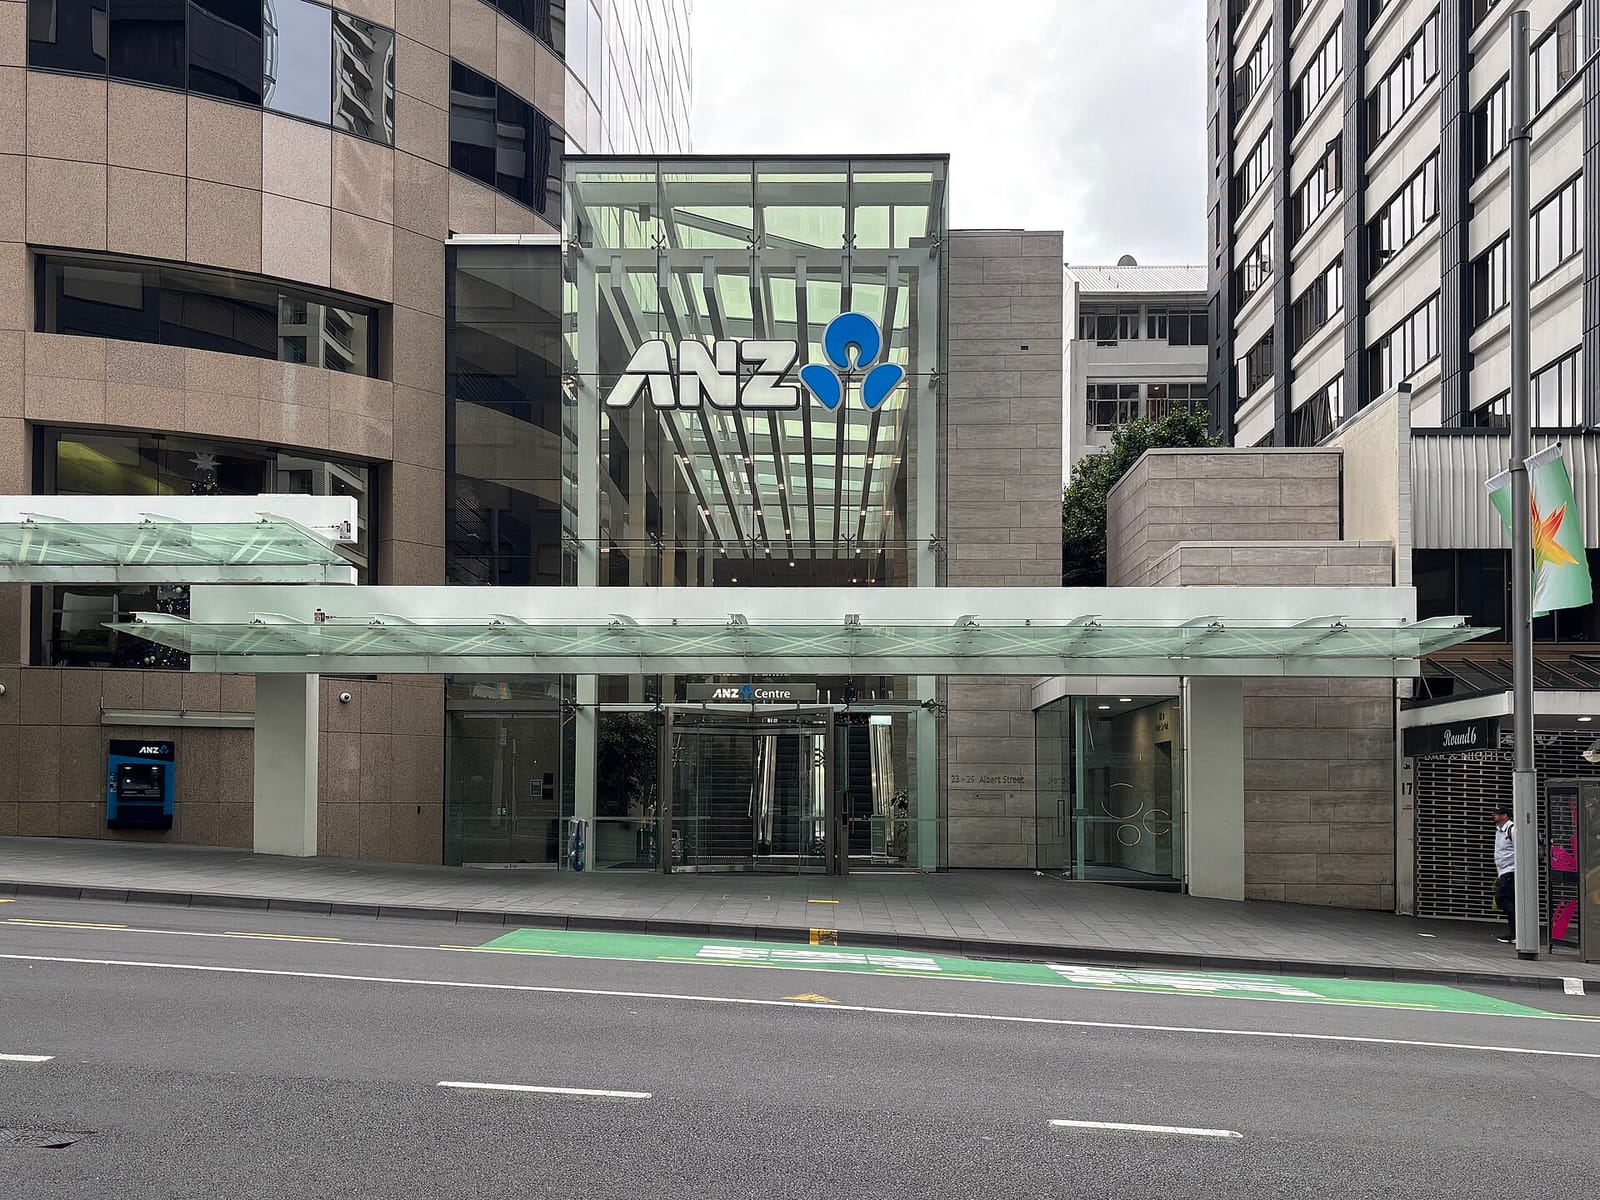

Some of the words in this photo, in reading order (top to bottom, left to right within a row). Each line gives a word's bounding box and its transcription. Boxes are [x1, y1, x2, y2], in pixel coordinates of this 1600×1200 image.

[606, 339, 801, 410] ANZ
[712, 688, 740, 699] ANZ
[754, 688, 791, 699] Centre
[139, 746, 160, 754] ANZ
[979, 774, 1002, 784] Albert
[1002, 774, 1025, 784] Street
[1402, 782, 1413, 795] 17
